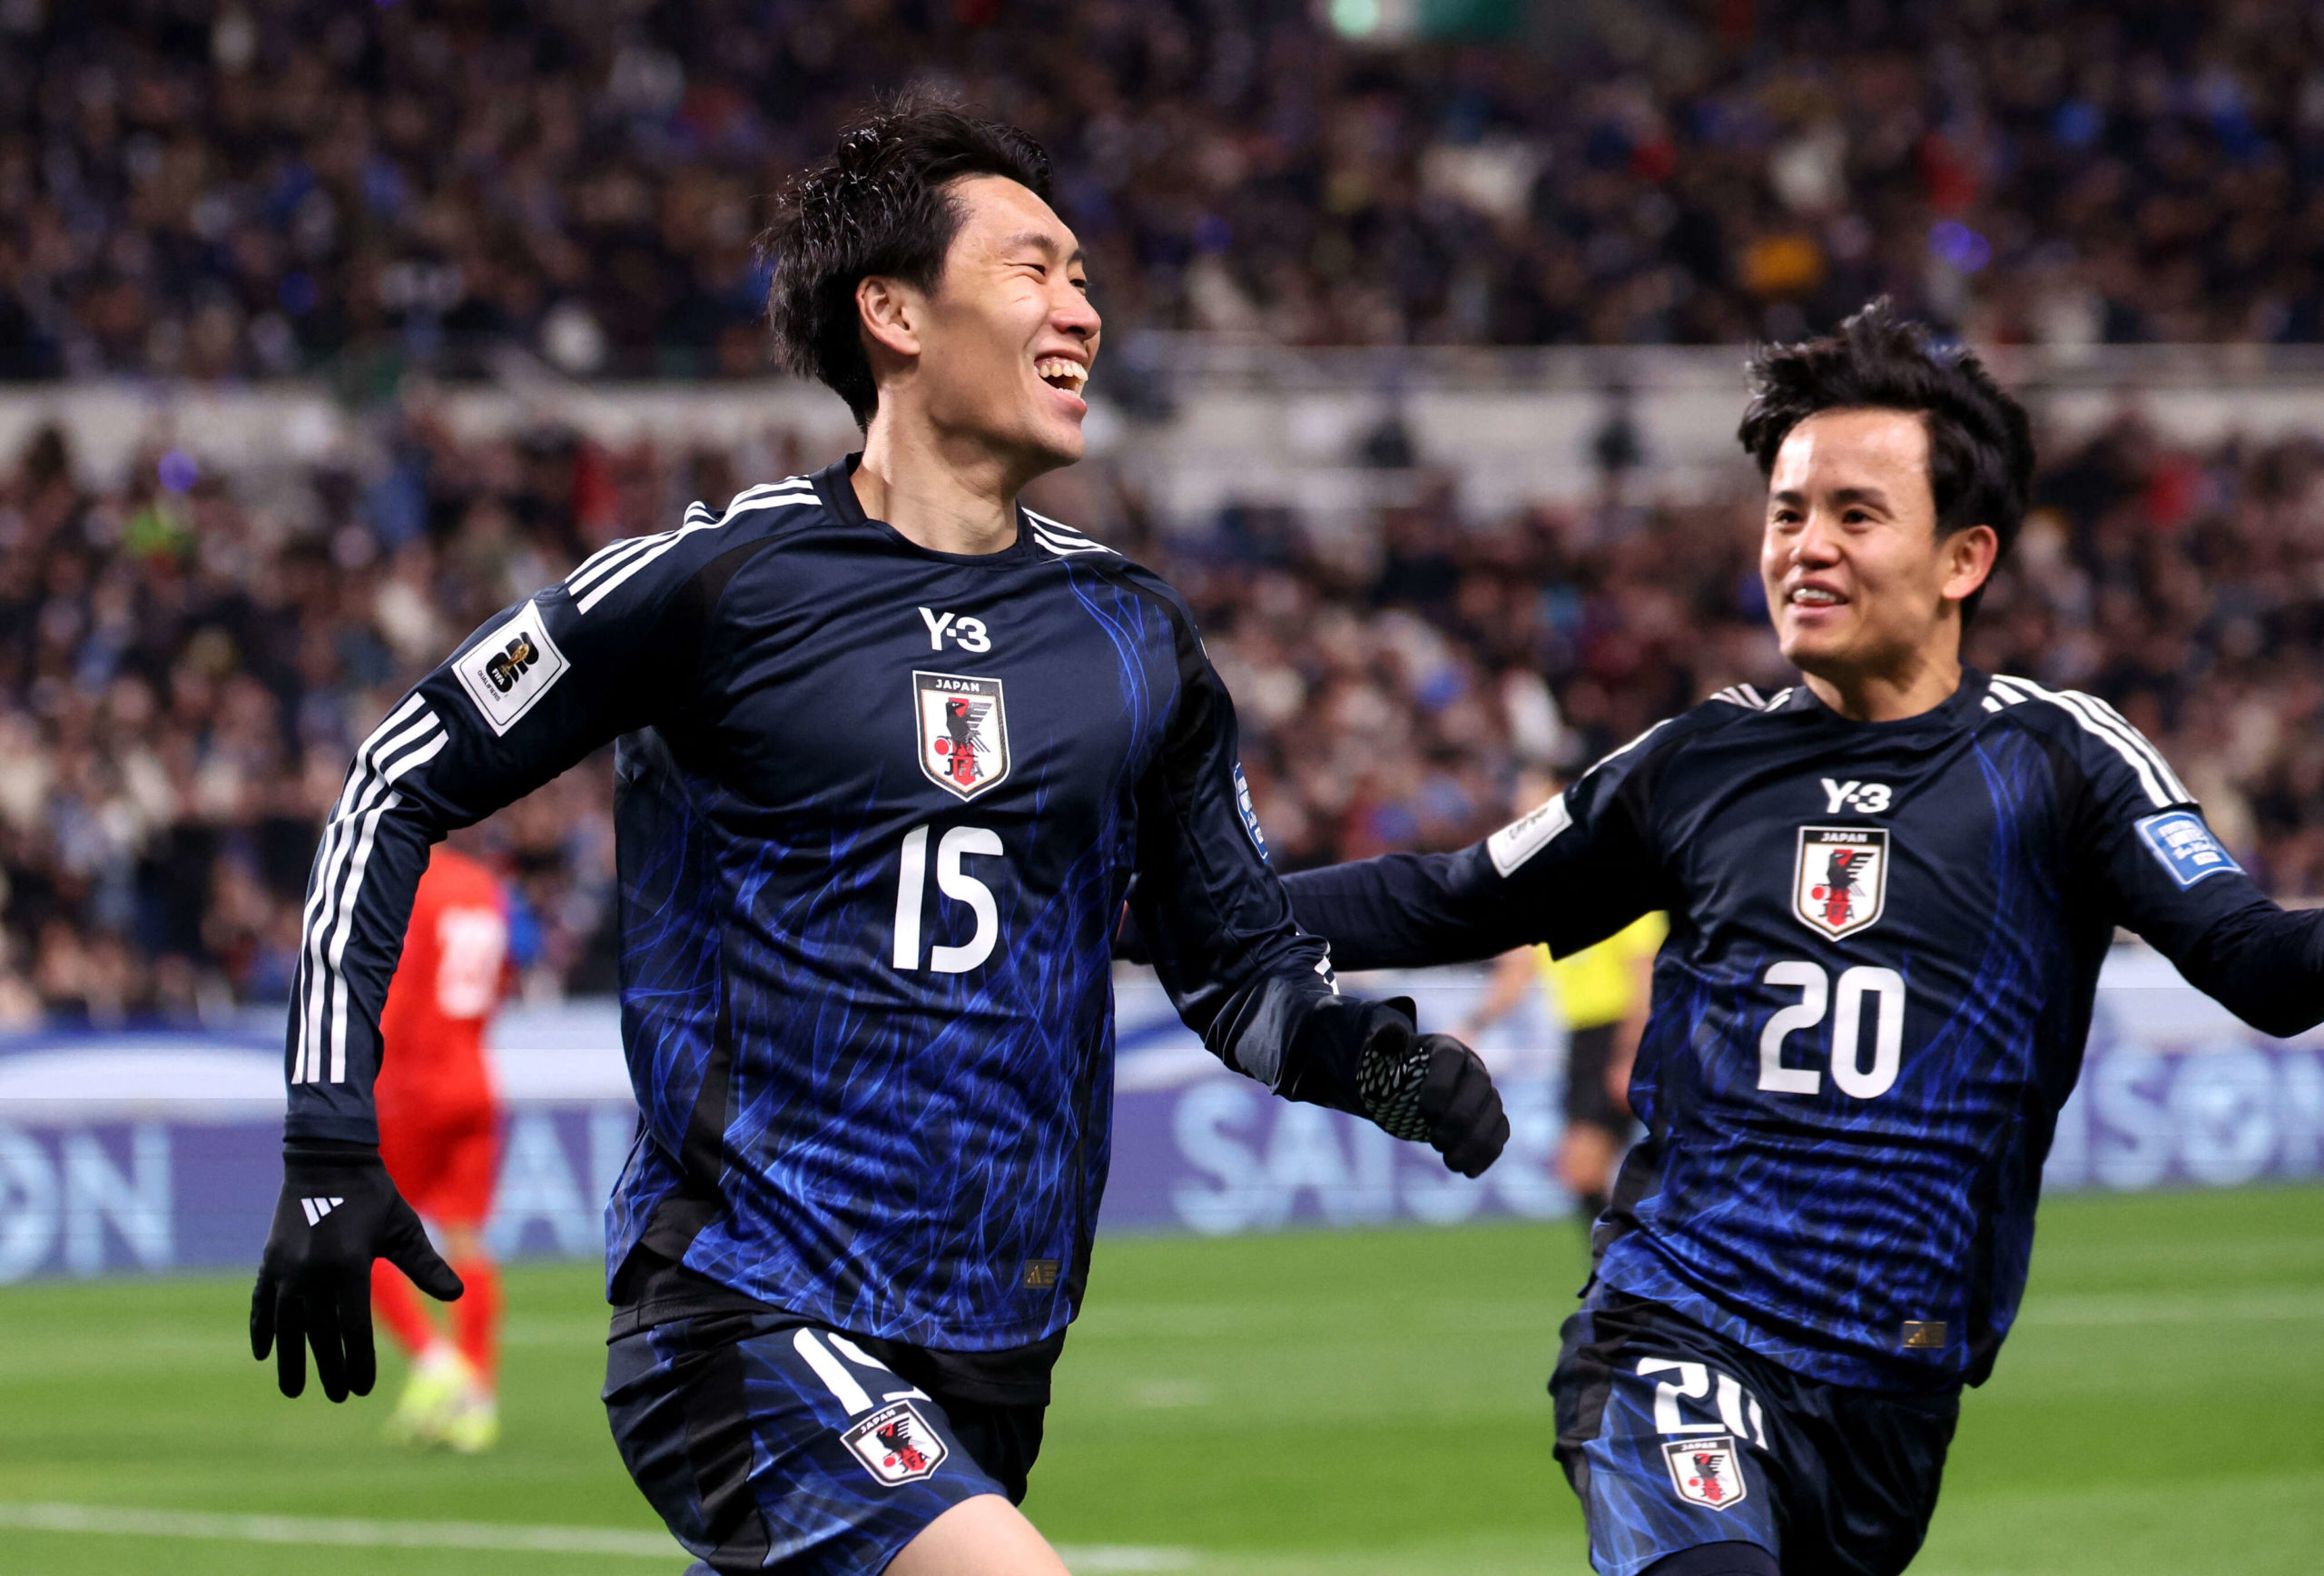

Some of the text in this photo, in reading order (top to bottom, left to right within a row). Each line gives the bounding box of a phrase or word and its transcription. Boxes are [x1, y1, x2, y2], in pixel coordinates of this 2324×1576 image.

[918, 606, 991, 653] Y-3
[477, 669, 501, 702] QUALIFIERS
[491, 667, 506, 686] FIFA
[935, 679, 980, 693] JAPAN
[944, 757, 984, 778] JFA
[1820, 777, 1893, 814] Y-3
[1820, 832, 1868, 843] JAPAN
[892, 823, 1004, 974] 15
[1757, 960, 1905, 1099] 20
[860, 1408, 897, 1434] JAPAN
[1679, 1441, 1718, 1452] JAPAN
